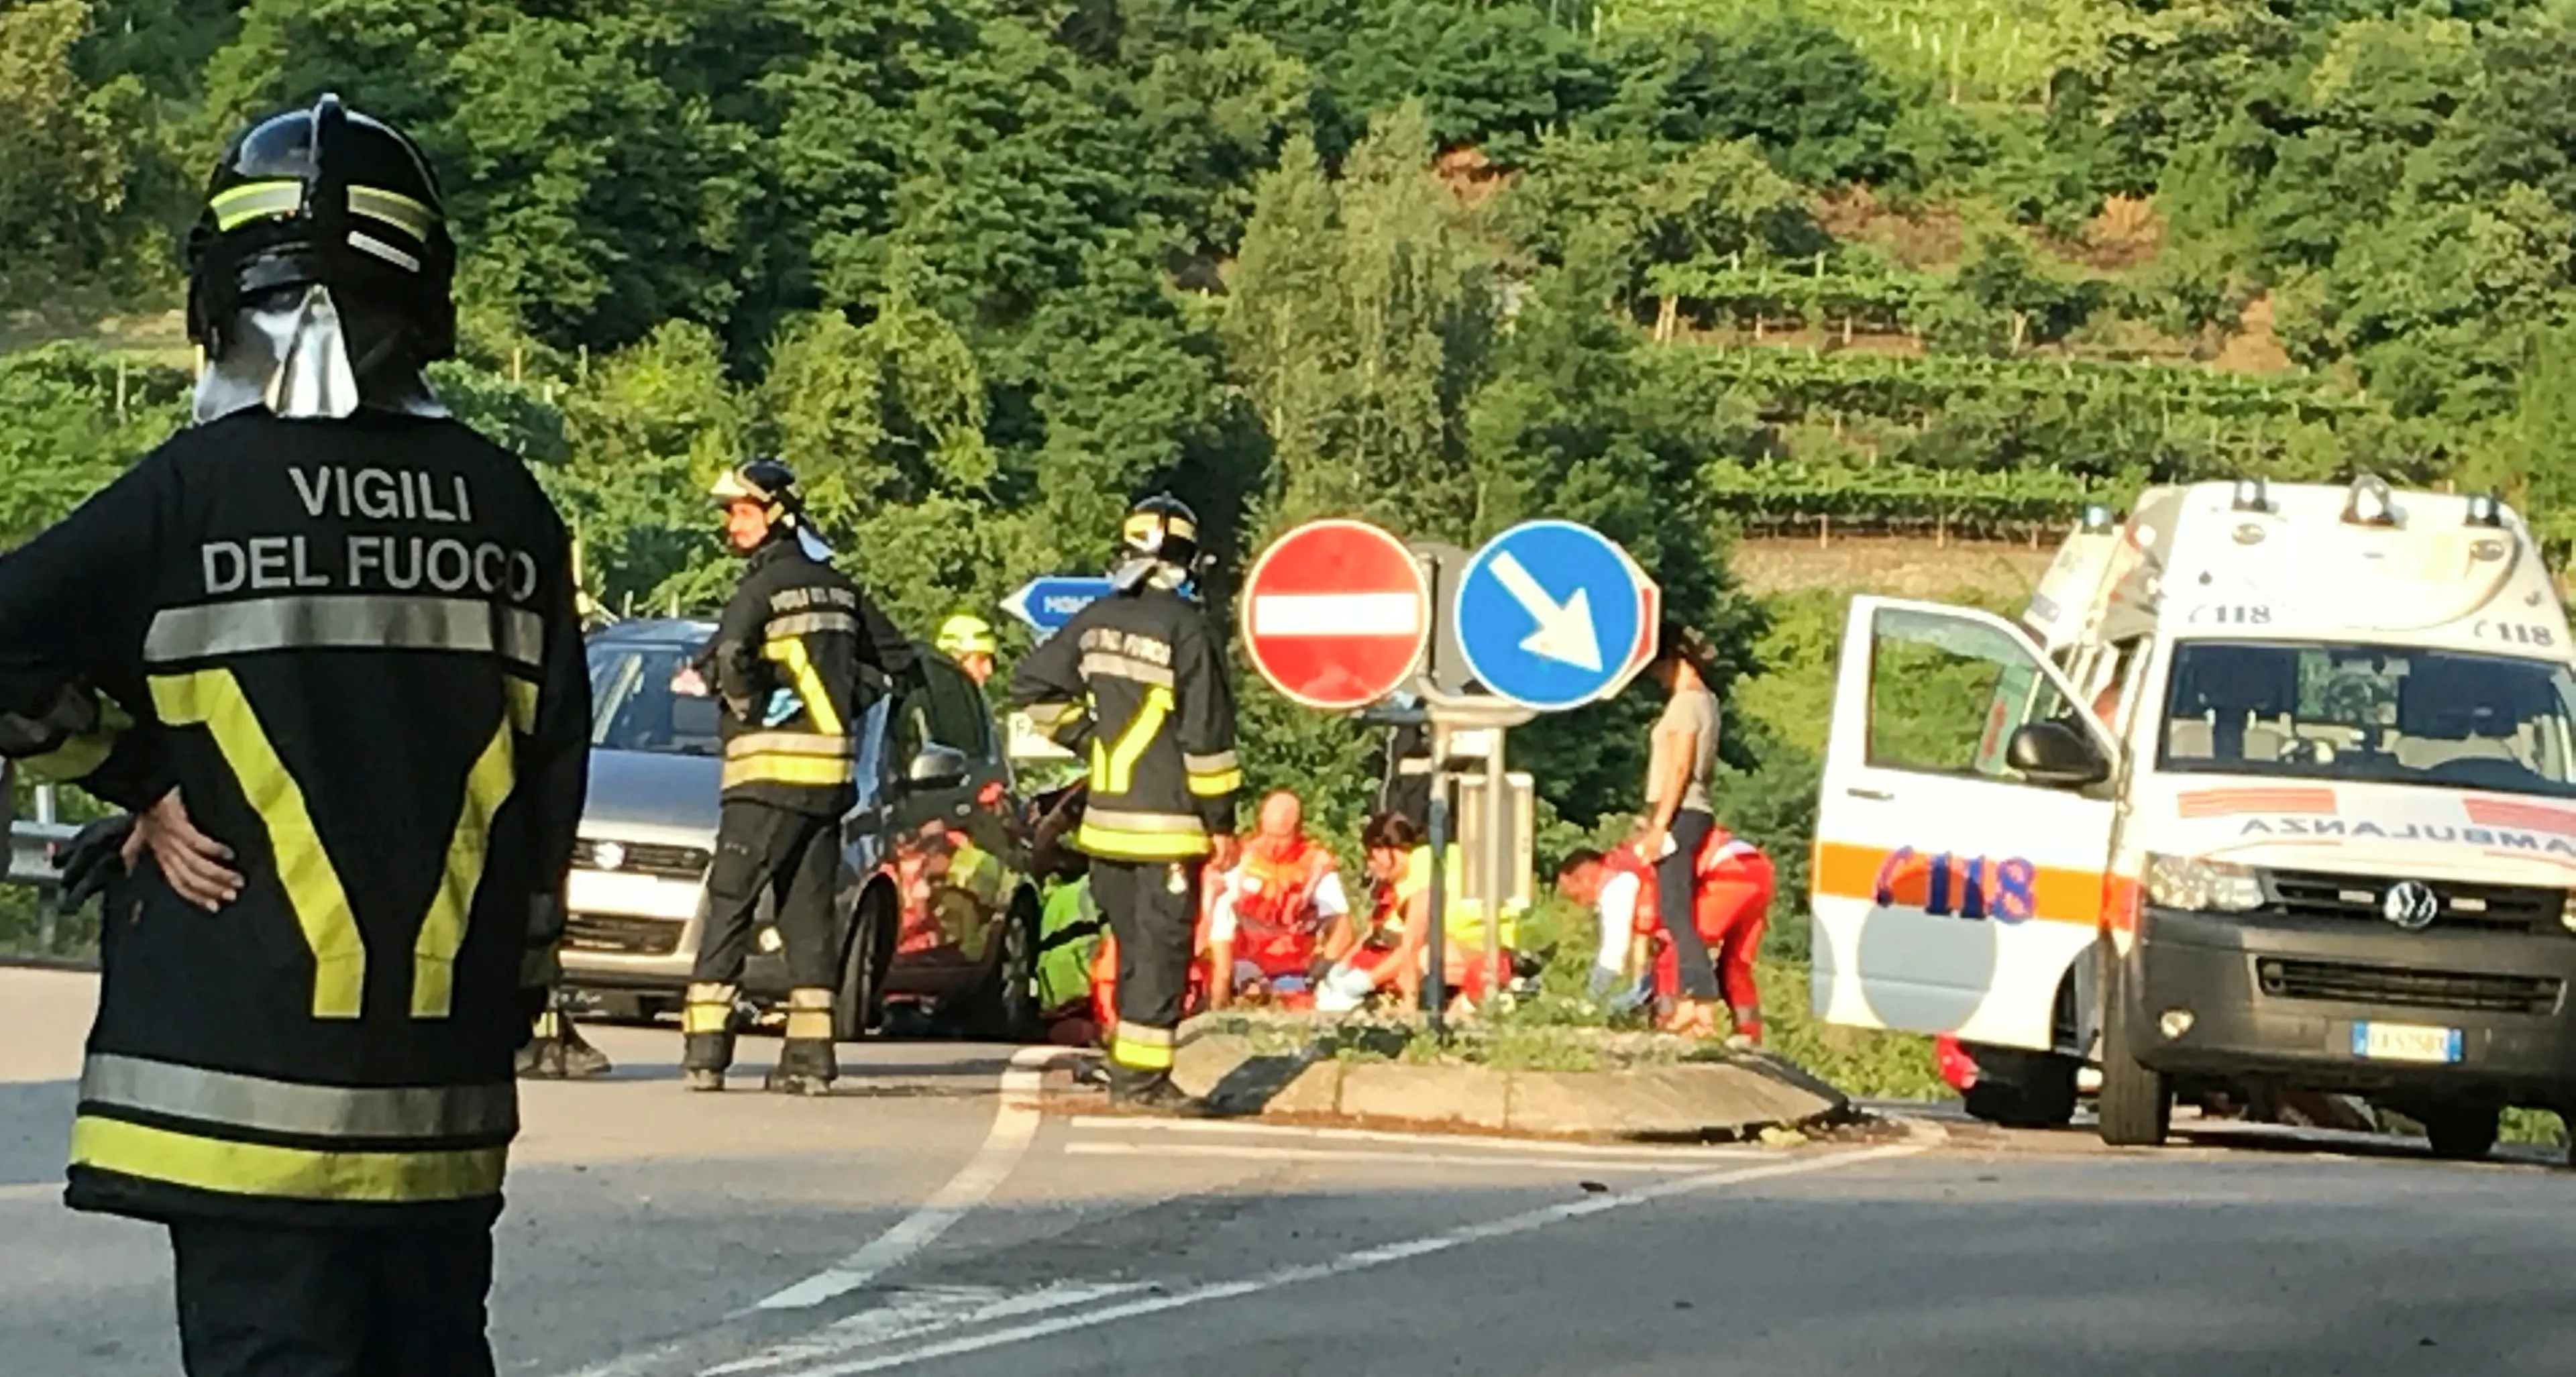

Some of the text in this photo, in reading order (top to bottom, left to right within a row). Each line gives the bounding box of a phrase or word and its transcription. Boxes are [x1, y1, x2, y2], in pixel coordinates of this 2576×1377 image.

[288, 466, 472, 522] VIGILI
[203, 536, 537, 602] DEL FUOCO
[2216, 604, 2271, 624] 118
[2496, 621, 2556, 648] 118
[1925, 850, 2037, 925] 118
